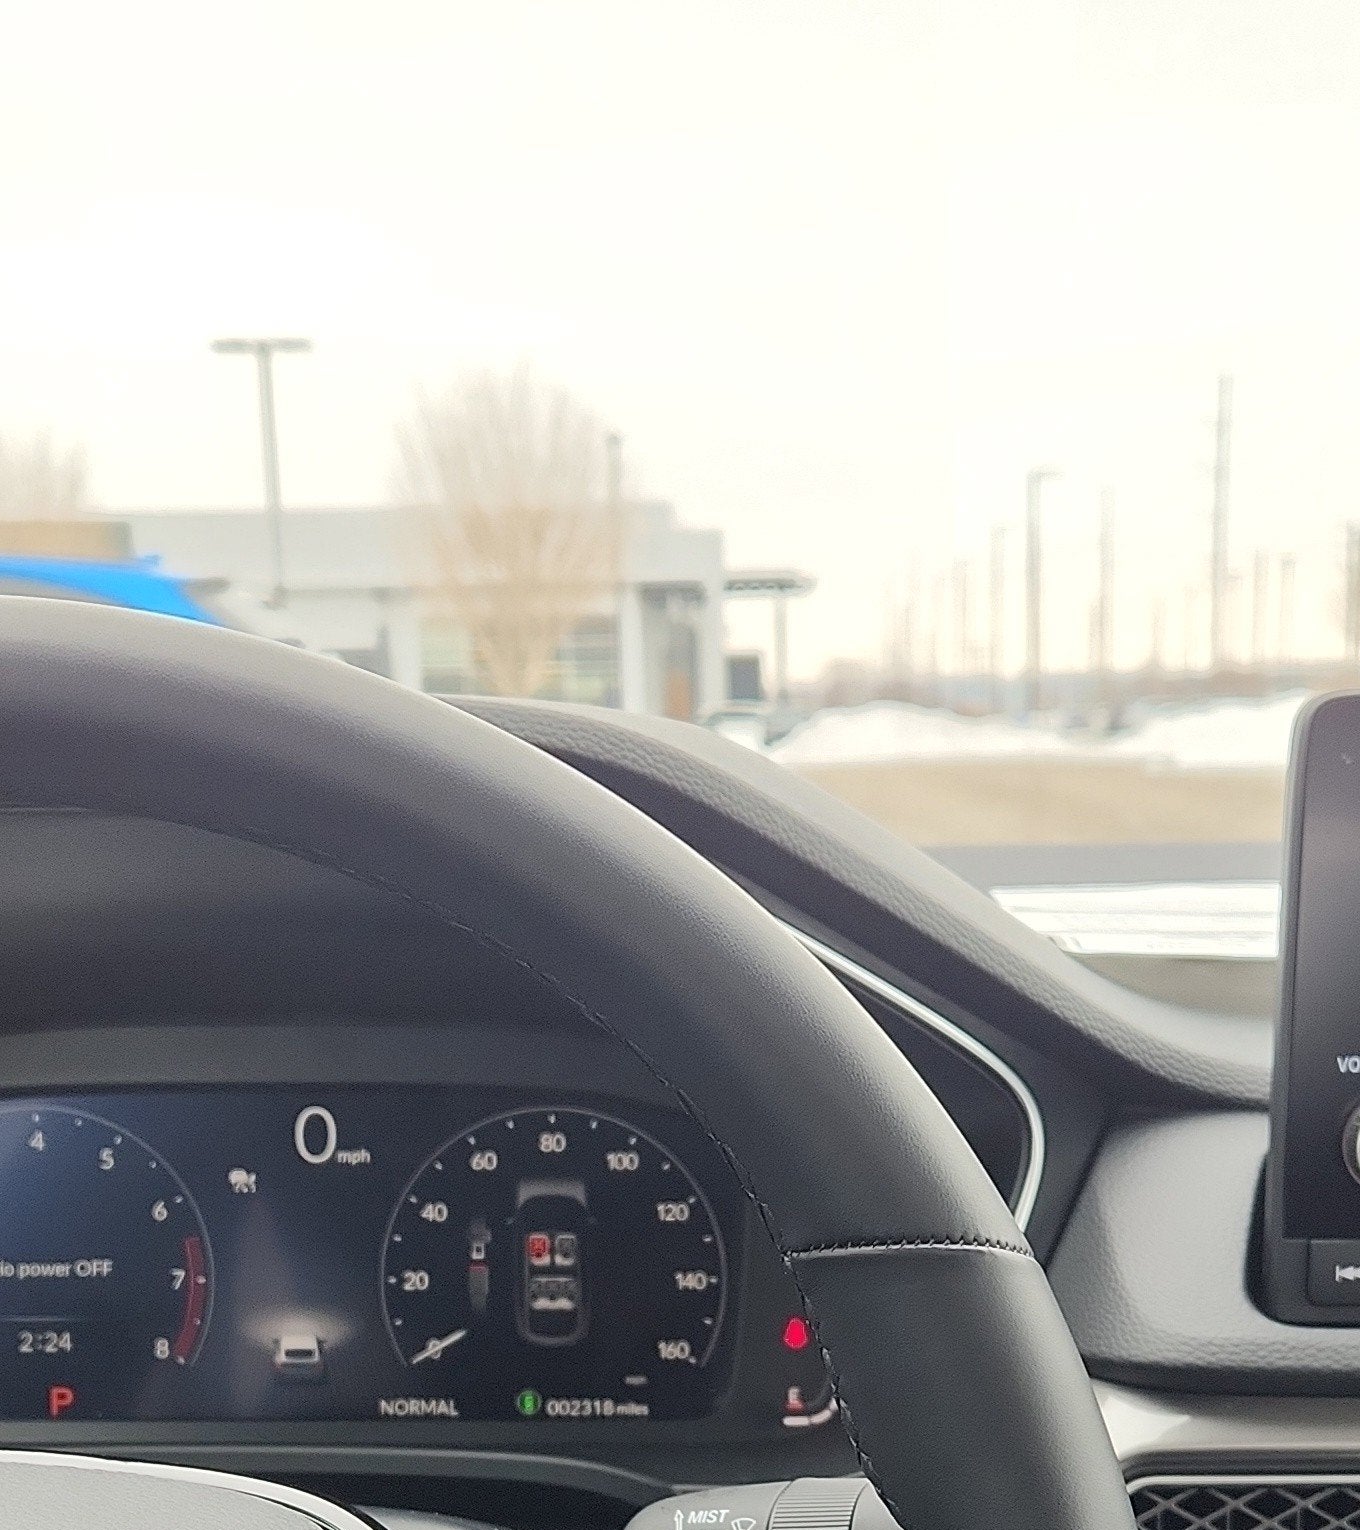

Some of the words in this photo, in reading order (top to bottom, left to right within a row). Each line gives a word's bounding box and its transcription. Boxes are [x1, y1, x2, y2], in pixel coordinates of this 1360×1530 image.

[29, 1130, 45, 1151] 4
[294, 1105, 338, 1164] 0
[338, 1147, 371, 1166] mph
[541, 1132, 567, 1153] 80
[99, 1148, 115, 1170] 5
[470, 1151, 497, 1172] 60
[607, 1151, 639, 1171] 100
[152, 1200, 168, 1221] 6
[421, 1202, 448, 1222] 40
[657, 1202, 690, 1222] 120
[18, 1262, 72, 1279] power
[74, 1259, 114, 1277] OFF
[171, 1268, 186, 1290] 7
[404, 1270, 430, 1290] 20
[676, 1270, 708, 1291] 140
[19, 1331, 72, 1353] 2:24
[154, 1338, 170, 1359] 8
[658, 1340, 690, 1361] 160
[47, 1385, 75, 1418] P
[379, 1399, 459, 1417] NORMAL
[546, 1399, 614, 1416] 002318
[616, 1403, 650, 1417] miles
[688, 1509, 730, 1524] MIST
